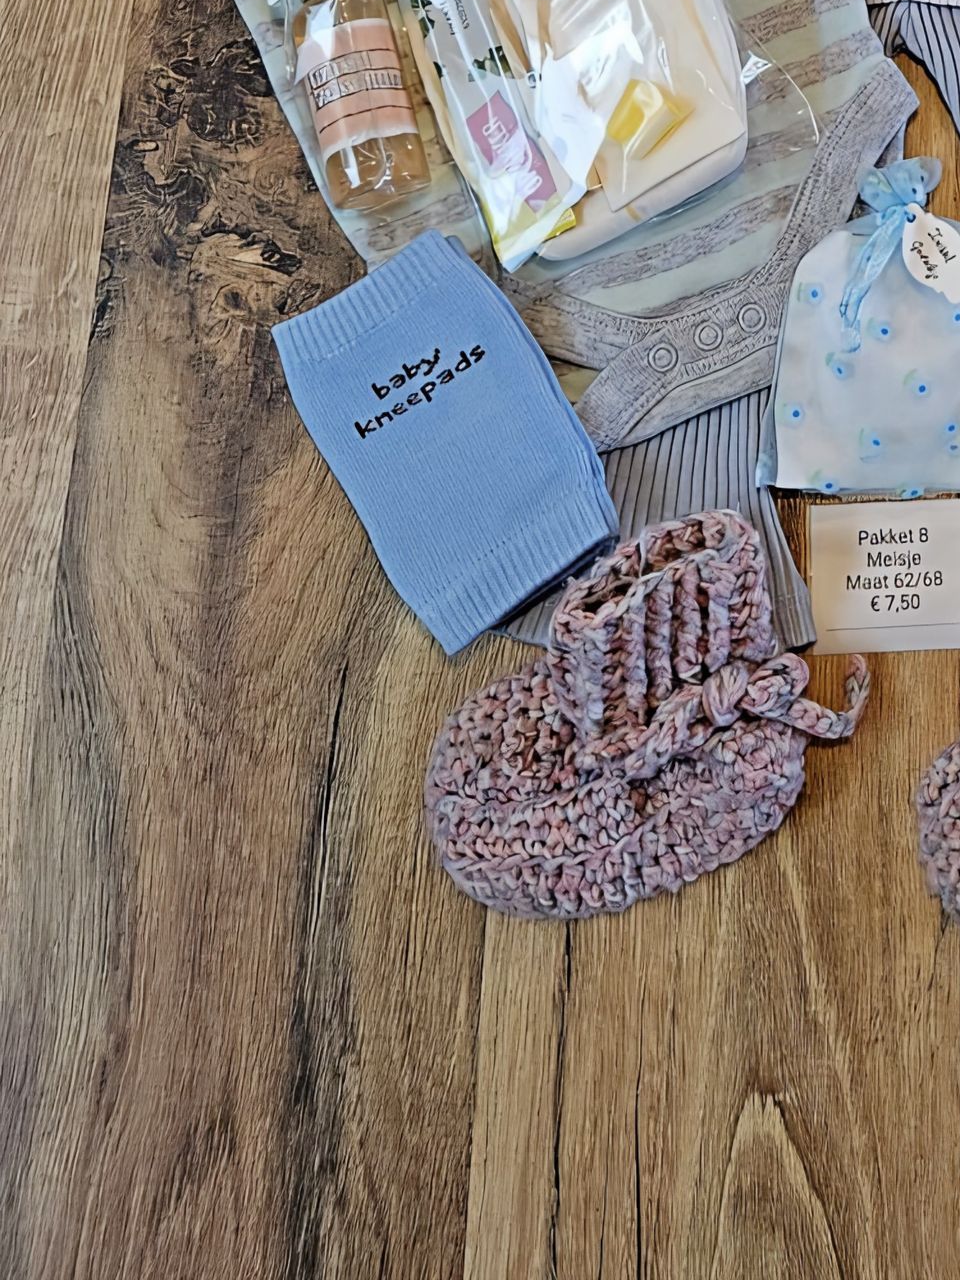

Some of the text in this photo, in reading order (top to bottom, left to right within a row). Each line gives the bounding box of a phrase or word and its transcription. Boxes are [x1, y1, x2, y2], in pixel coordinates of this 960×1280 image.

[371, 347, 441, 400] baby
[354, 344, 486, 440] kneepads
[858, 528, 914, 546] Pakket
[867, 551, 921, 569] Meisje
[846, 570, 943, 590] Maat 62/68
[884, 594, 921, 613] 7,50
